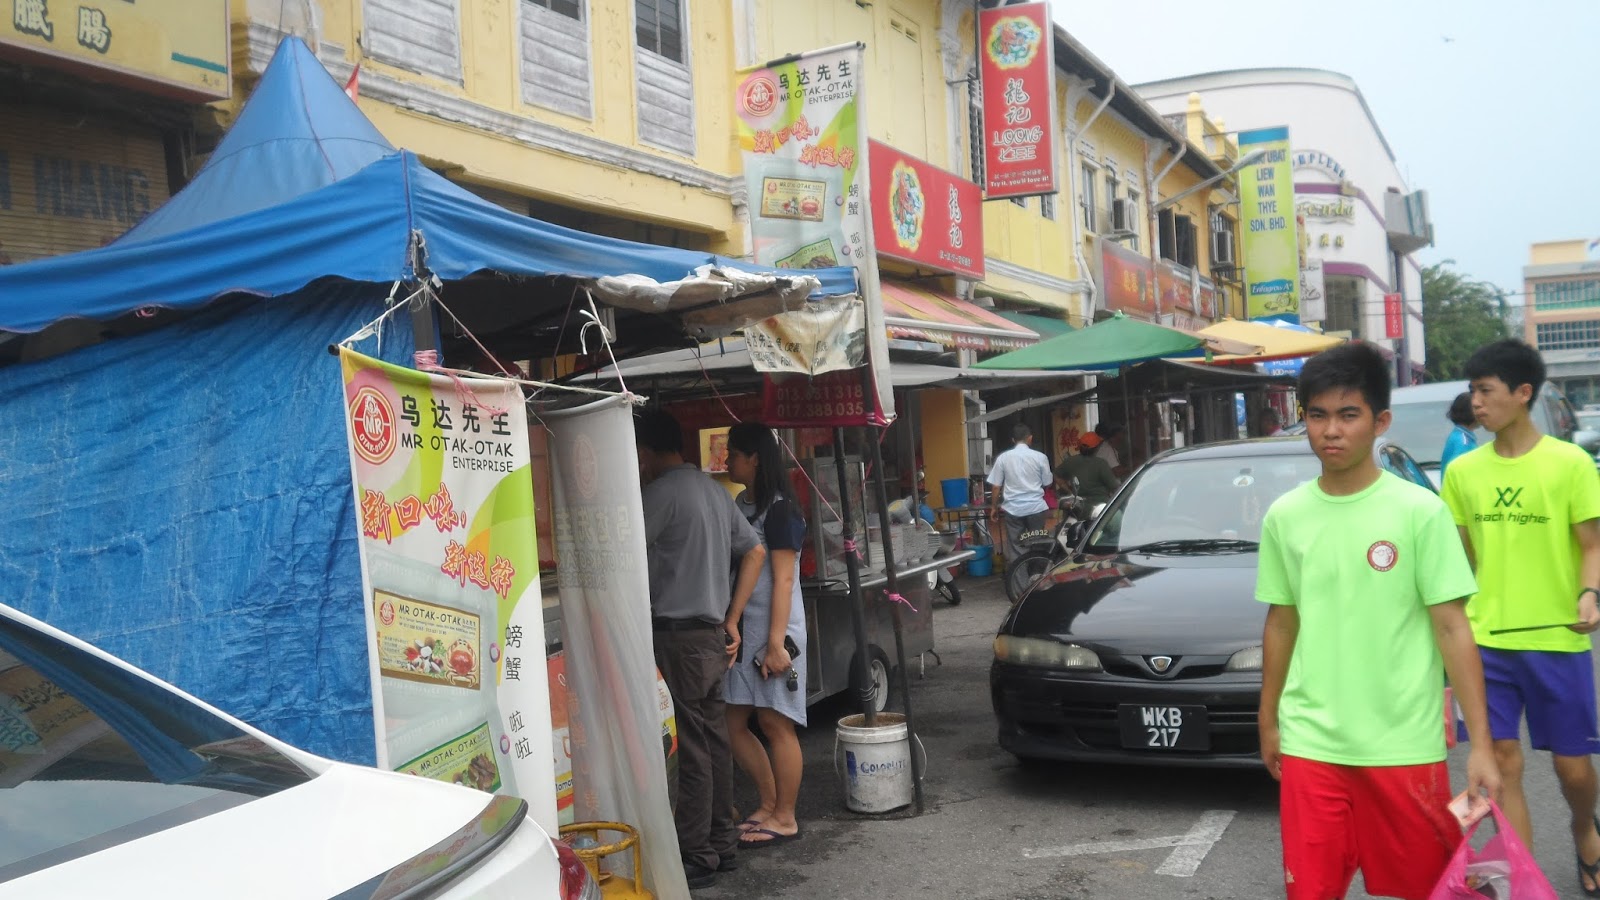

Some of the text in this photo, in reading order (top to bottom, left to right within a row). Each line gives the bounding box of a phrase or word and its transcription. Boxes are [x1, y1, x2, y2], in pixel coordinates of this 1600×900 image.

[779, 60, 852, 90] 乌达先生
[780, 79, 853, 103] MR OTAK-OTAK
[808, 90, 853, 105] ENTERPRISE
[993, 126, 1043, 146] LOONG
[998, 145, 1037, 163] KEE
[1267, 149, 1287, 163] UBAT
[1256, 167, 1275, 181] LIEW
[1258, 184, 1275, 197] WAN
[1258, 200, 1278, 214] THYE
[1250, 216, 1288, 232] SDN. BHD.
[365, 414, 383, 435] MR
[400, 394, 512, 436] 乌达先生
[401, 433, 514, 457] MR OTAK-OTAK
[452, 456, 514, 473] ENTERPRISE
[1508, 513, 1551, 525] higher
[399, 604, 410, 615] MR
[413, 607, 462, 627] OTAK-OTAK
[505, 624, 523, 682] 螃蟹
[1142, 706, 1183, 727] WKB
[508, 710, 533, 760] 啦啦
[1147, 727, 1181, 748] 217
[420, 760, 432, 773] MR
[433, 736, 477, 765] OTAK-OTAK
